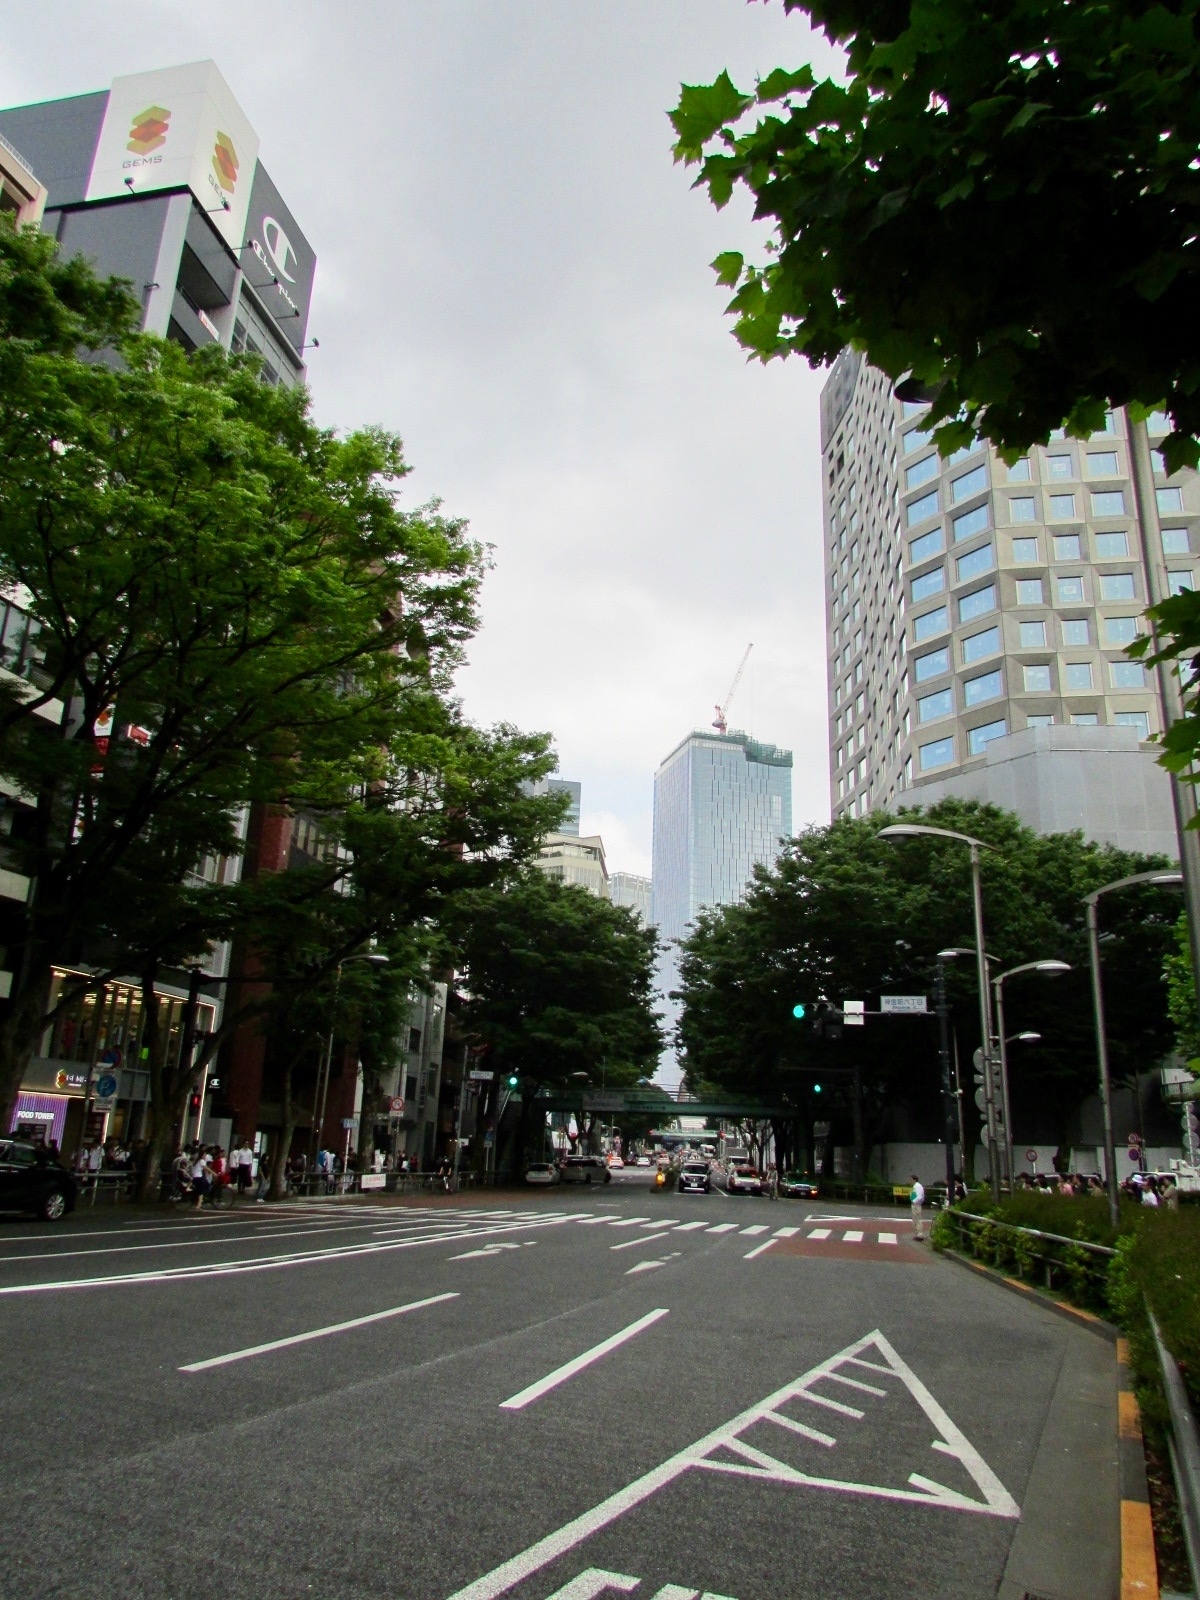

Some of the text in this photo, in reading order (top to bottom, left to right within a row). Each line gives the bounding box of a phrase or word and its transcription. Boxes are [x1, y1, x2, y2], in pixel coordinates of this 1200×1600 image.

[122, 156, 163, 169] GEMS
[17, 1110, 55, 1120] FOOD TOWER
